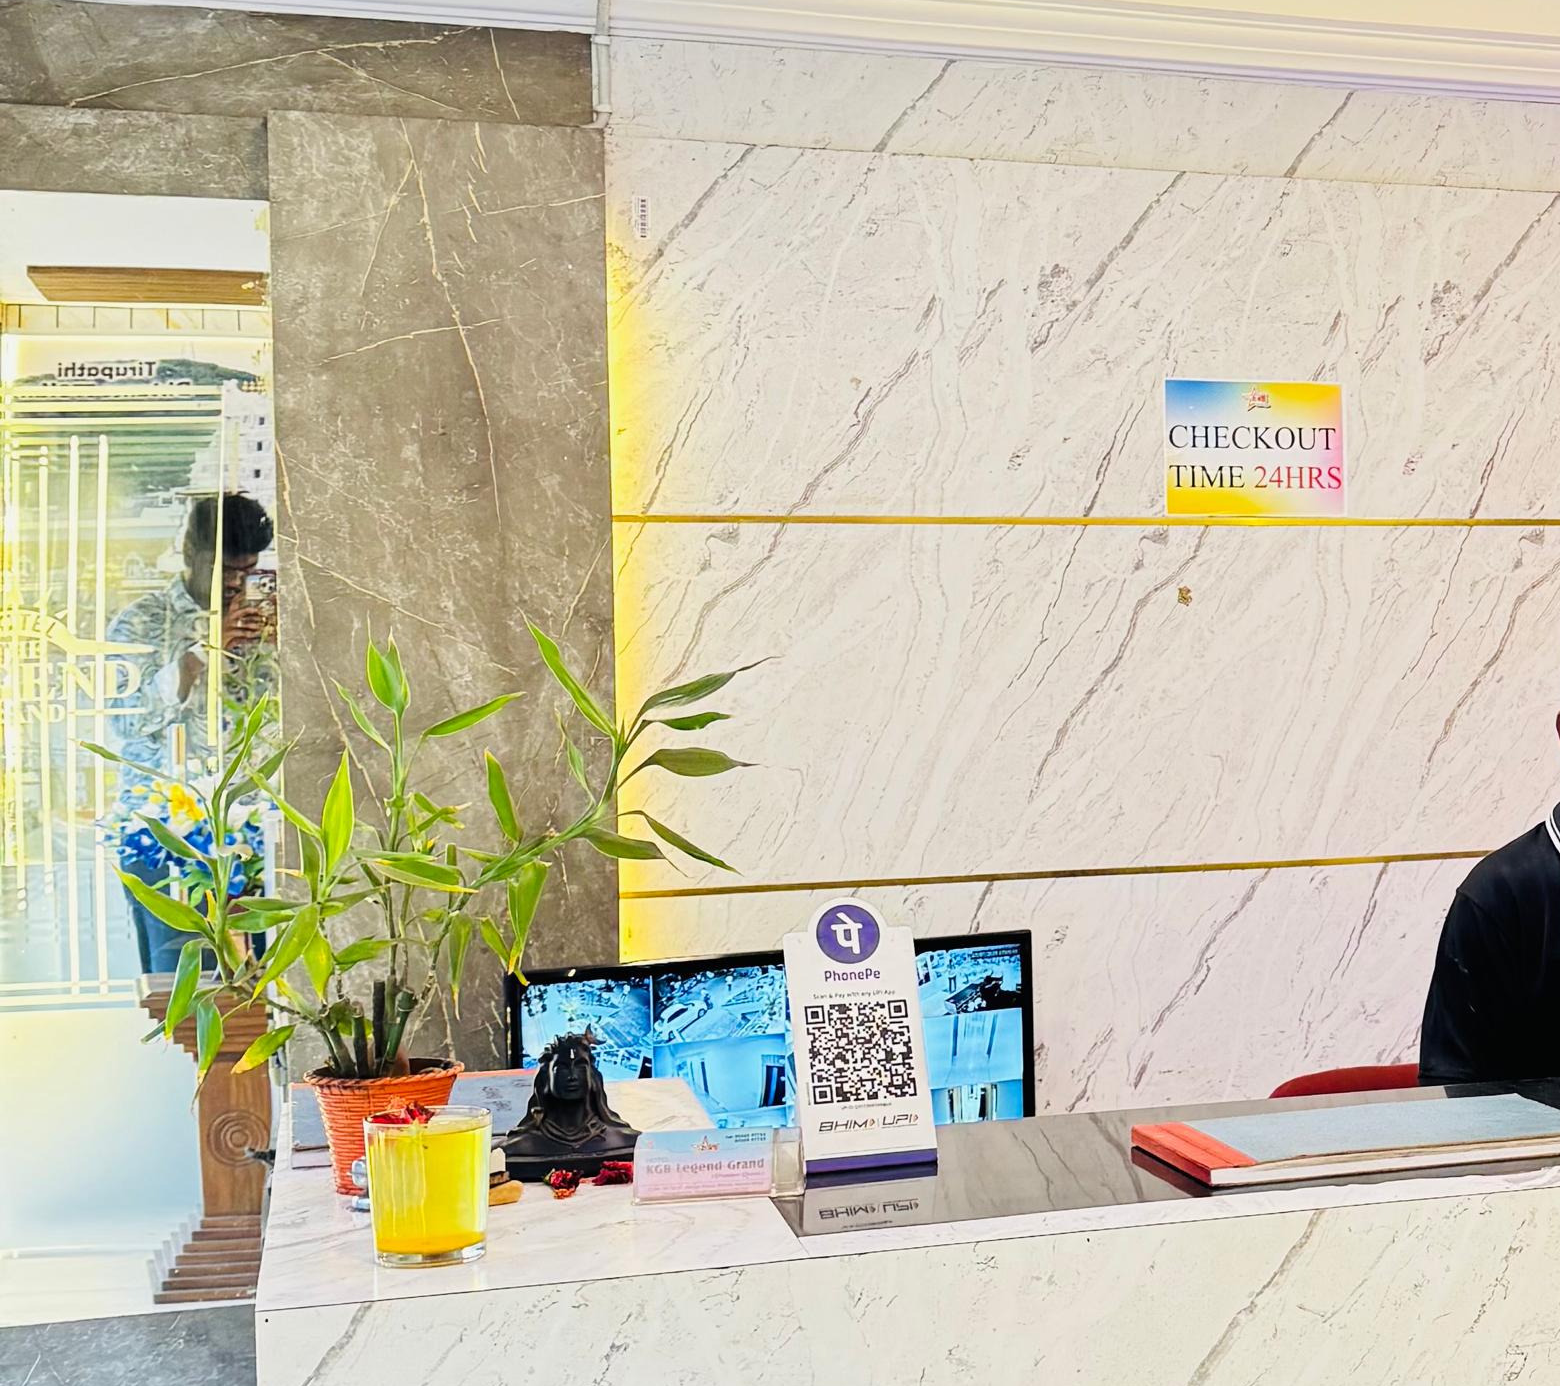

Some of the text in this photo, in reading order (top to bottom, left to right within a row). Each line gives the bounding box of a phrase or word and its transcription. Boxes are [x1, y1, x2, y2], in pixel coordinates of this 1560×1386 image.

[1168, 424, 1336, 451] CHECKOUT
[1168, 464, 1342, 490] TIME 24HRS
[823, 967, 881, 983] PhonePe
[818, 1113, 912, 1133] BHIM UPI
[646, 1157, 765, 1175] KGB Legend Grand
